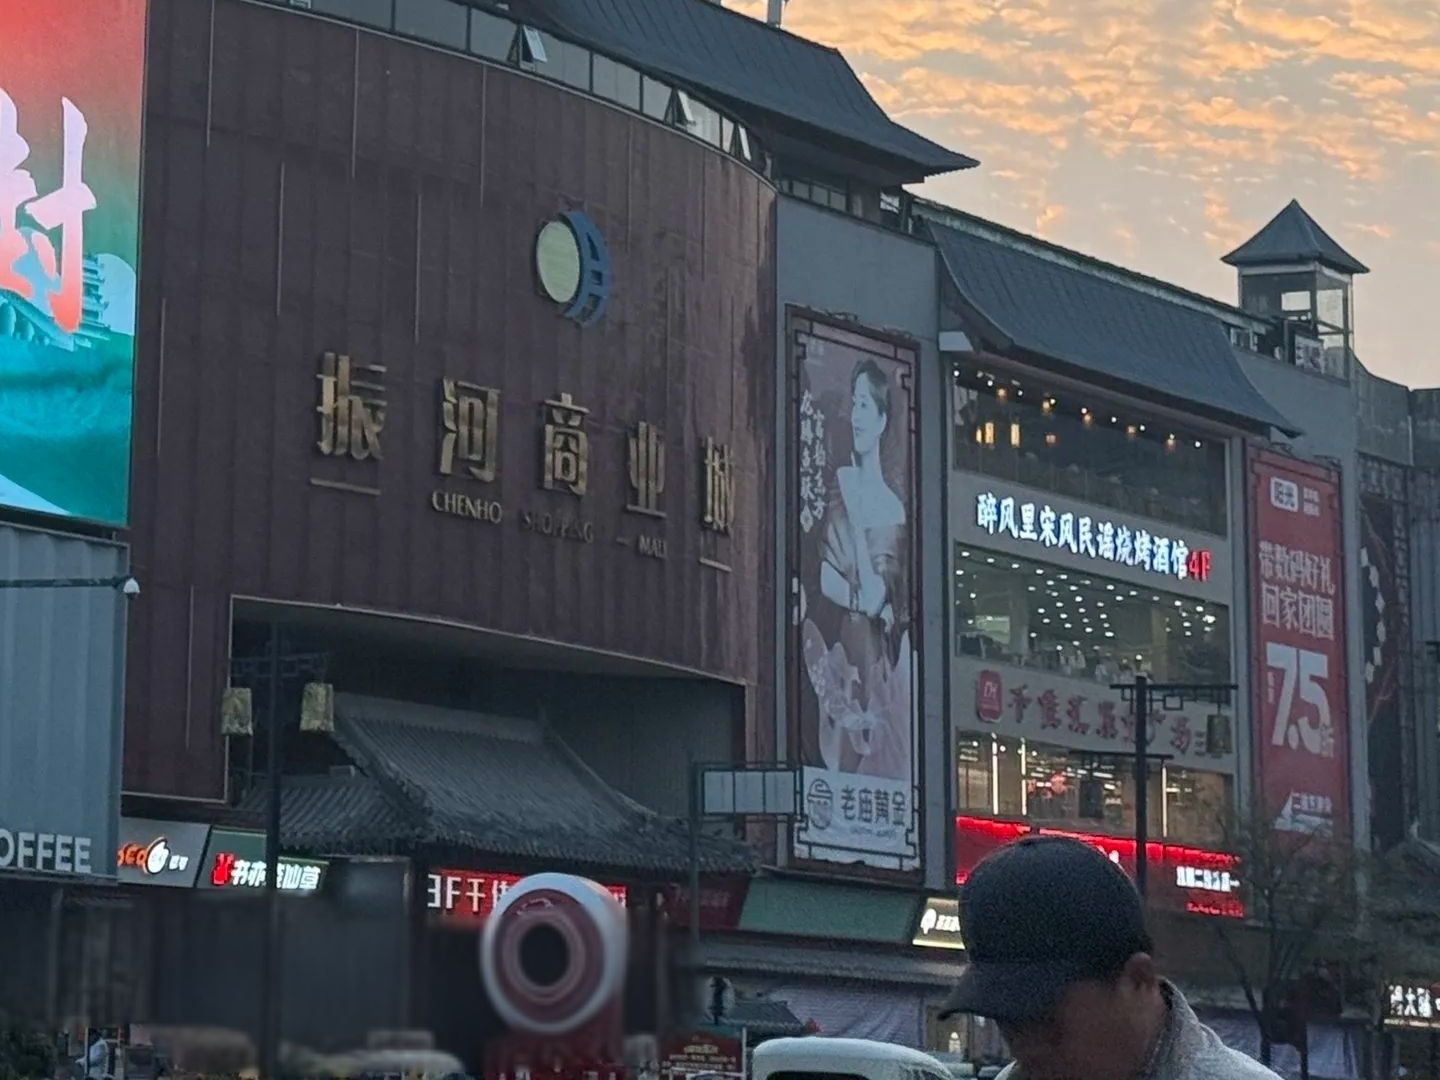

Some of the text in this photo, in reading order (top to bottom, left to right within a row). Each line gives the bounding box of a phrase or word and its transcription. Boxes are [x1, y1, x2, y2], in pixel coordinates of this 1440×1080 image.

[976, 492, 1211, 583] 醉风里宋风民谣烧烤酒馆 4F
[1262, 582, 1335, 641] 回家团圆
